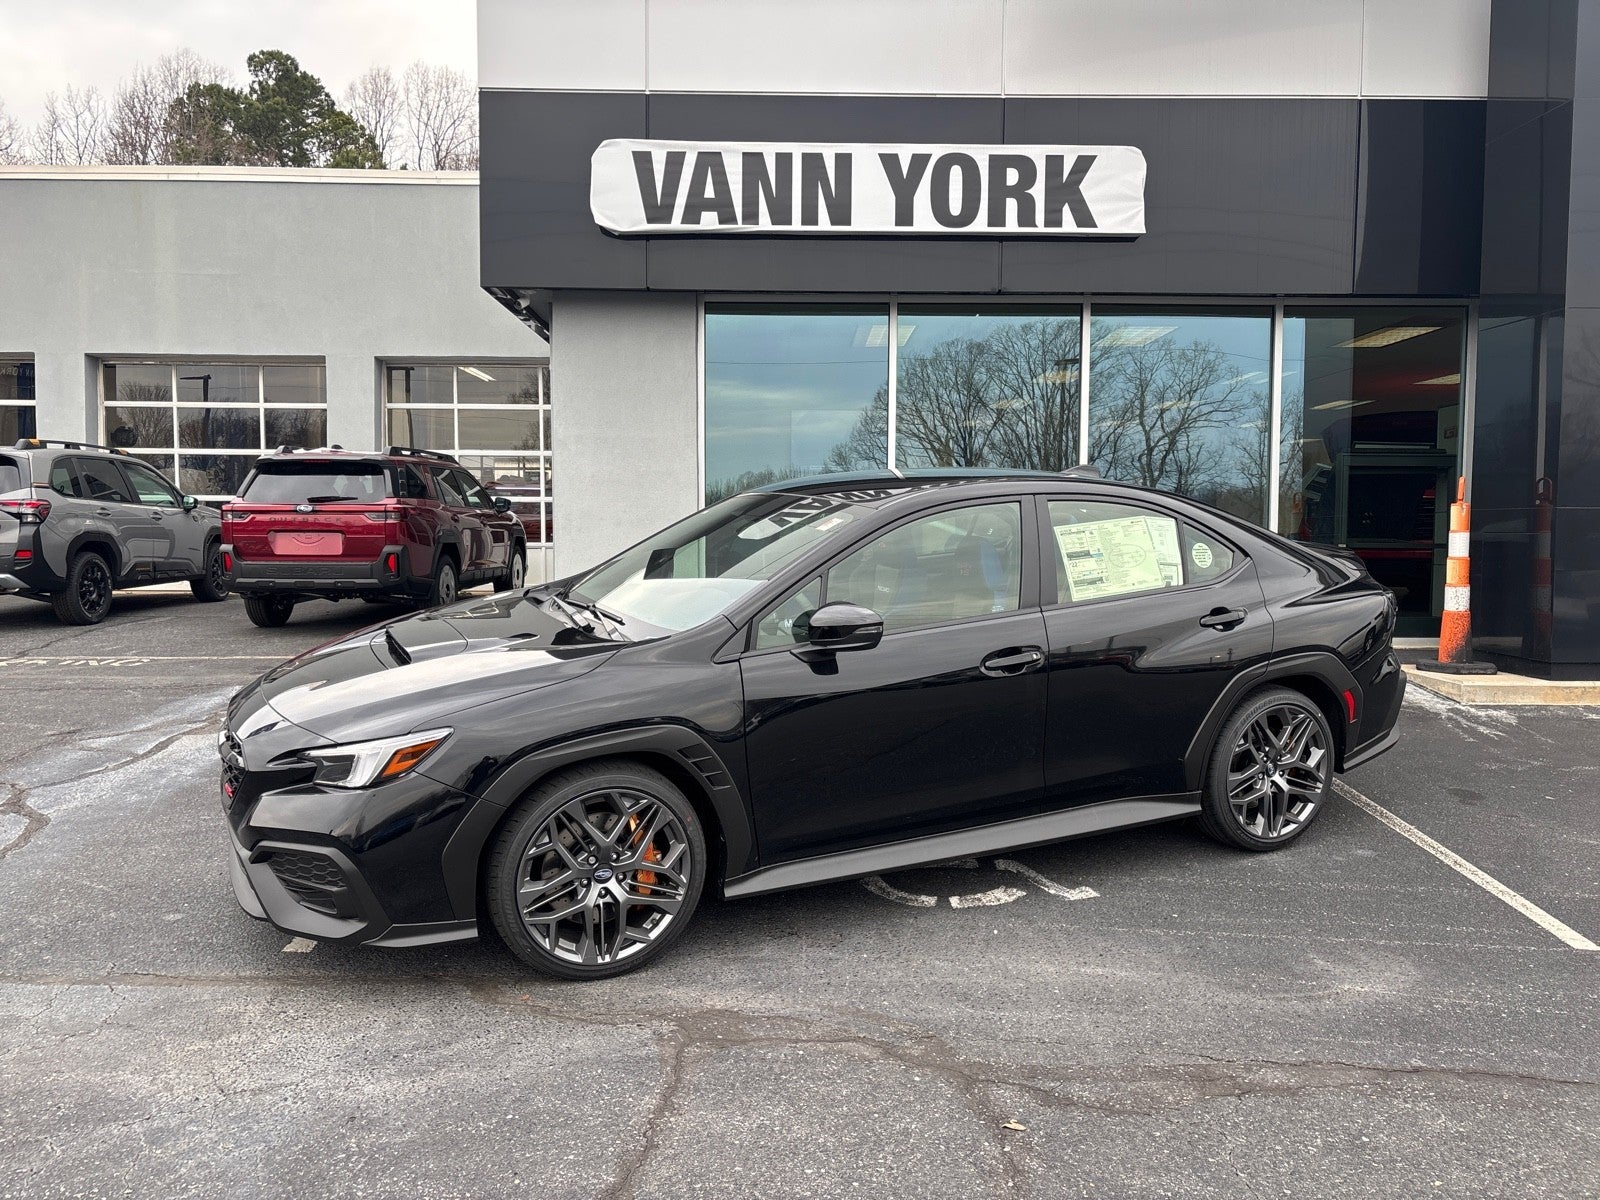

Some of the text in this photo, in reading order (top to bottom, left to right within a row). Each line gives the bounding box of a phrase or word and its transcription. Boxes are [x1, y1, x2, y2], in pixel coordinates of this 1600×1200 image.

[631, 150, 1099, 229] VANN YORK
[265, 567, 344, 576] SUBARU
